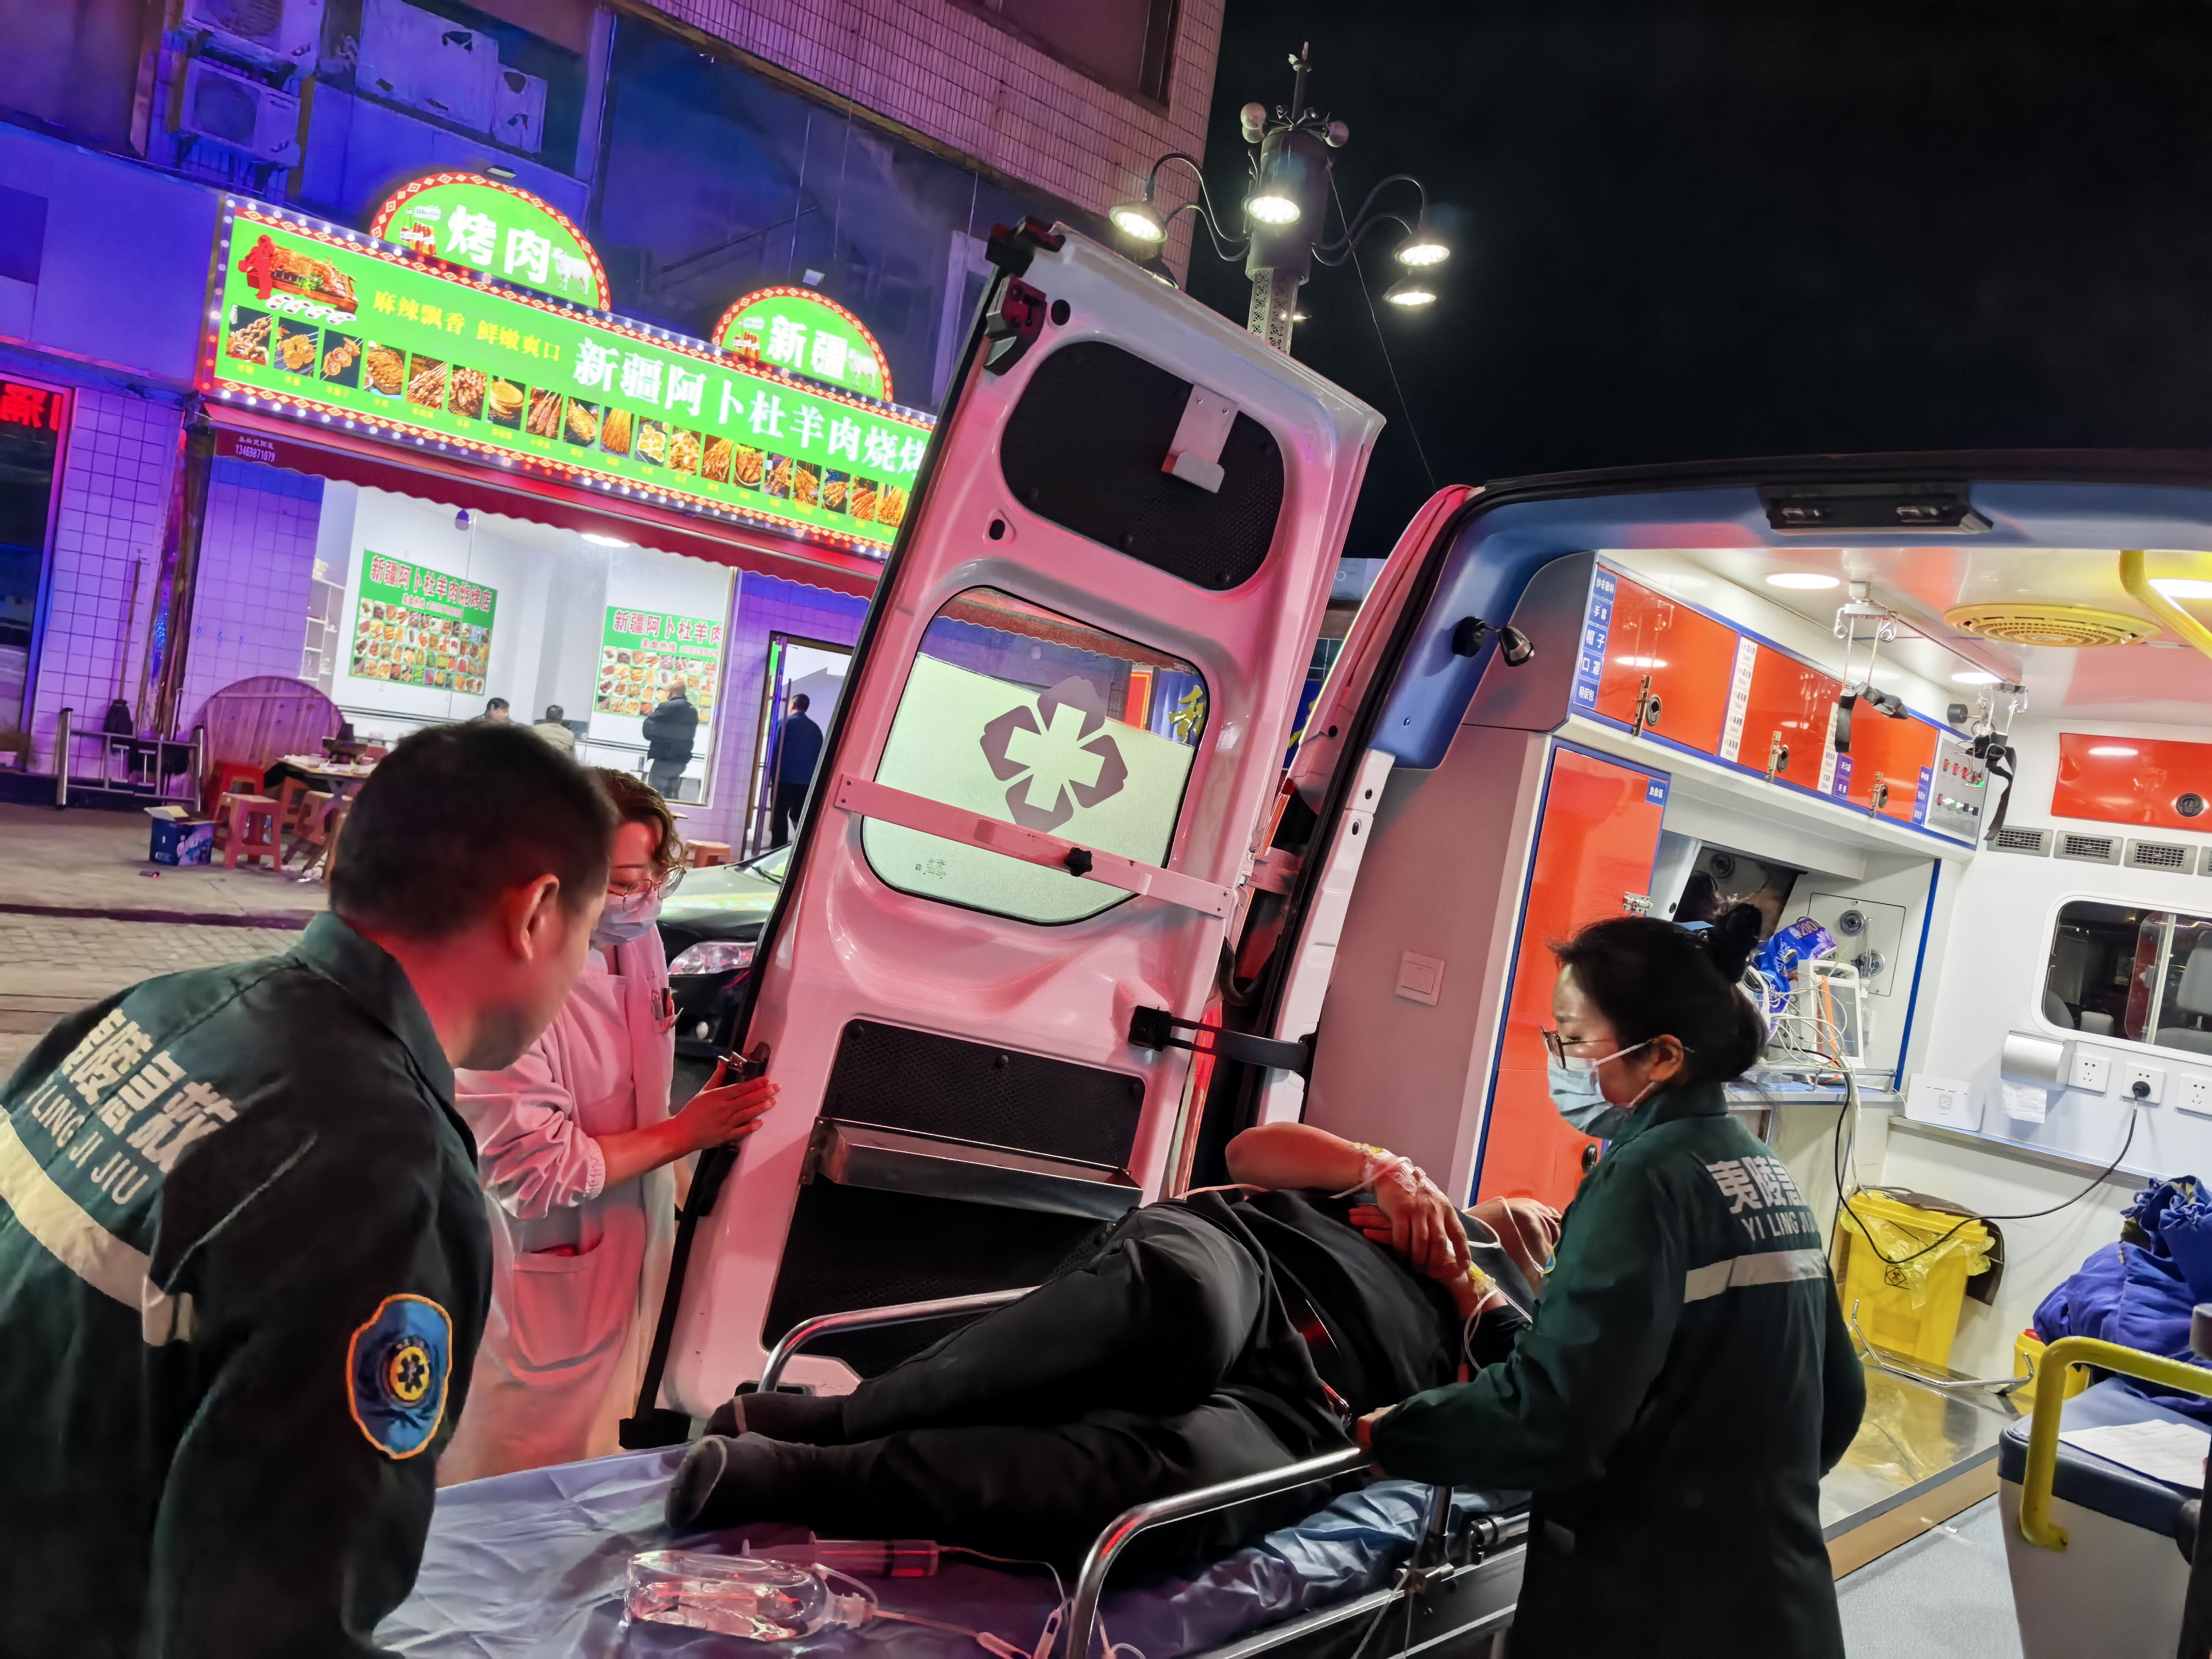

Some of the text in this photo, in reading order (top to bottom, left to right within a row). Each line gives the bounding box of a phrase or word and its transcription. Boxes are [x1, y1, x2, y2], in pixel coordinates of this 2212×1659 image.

[445, 204, 551, 284] 烤肉
[373, 291, 465, 335] 麻辣飘香
[766, 315, 848, 380] 新疆
[370, 555, 493, 613] 新疆阿卜杜羊肉烧烤店
[1596, 577, 1615, 594] 纱布敷料
[613, 610, 723, 646] 新疆阿卜杜羊肉
[1594, 605, 1608, 621] 手套
[1586, 629, 1606, 648] 帽子
[1582, 658, 1601, 676] 口罩
[1579, 686, 1595, 702] 导尿包
[31, 1084, 86, 1148] LING
[69, 1131, 104, 1169] JI
[90, 1151, 150, 1205] JIU
[1741, 1216, 1766, 1242] YI
[1766, 1212, 1800, 1237] LING
